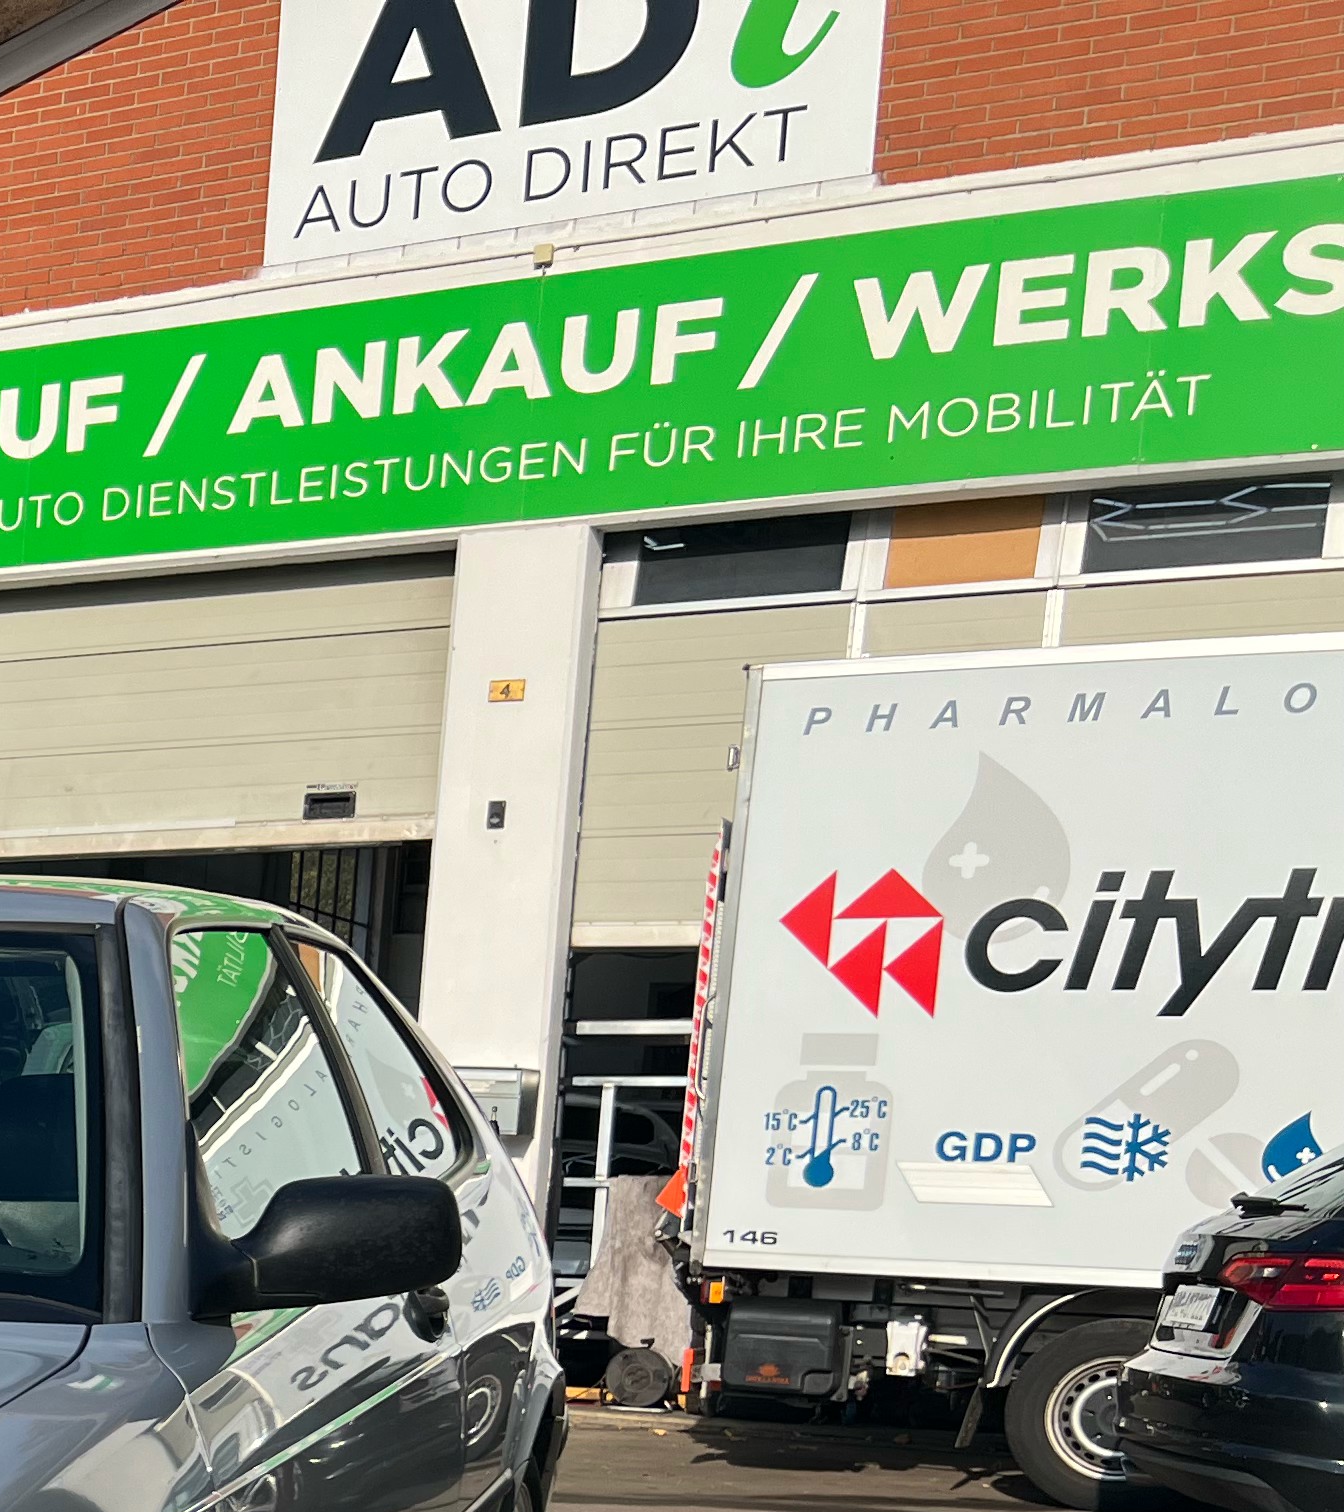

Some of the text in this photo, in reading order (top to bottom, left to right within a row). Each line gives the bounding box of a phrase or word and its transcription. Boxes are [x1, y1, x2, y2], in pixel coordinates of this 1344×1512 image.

[293, 104, 810, 240] AUTO DIREKT
[144, 354, 208, 457] /
[228, 296, 725, 435] ANKAUF
[737, 272, 821, 391] /
[853, 223, 1344, 362] WERKS
[102, 436, 590, 523] DIENSTLEISTUNGEN
[607, 421, 716, 473] FÜR
[736, 407, 868, 460] IHRE
[886, 372, 1212, 445] MOBILITÄT
[803, 682, 1318, 735] PHARMALO
[764, 1109, 798, 1131] 15°C
[849, 1097, 887, 1119] 25°C
[852, 1129, 879, 1151] 8°C
[935, 1131, 1037, 1163] GDP
[765, 1144, 793, 1166] 2°C
[723, 1230, 778, 1245] 146
